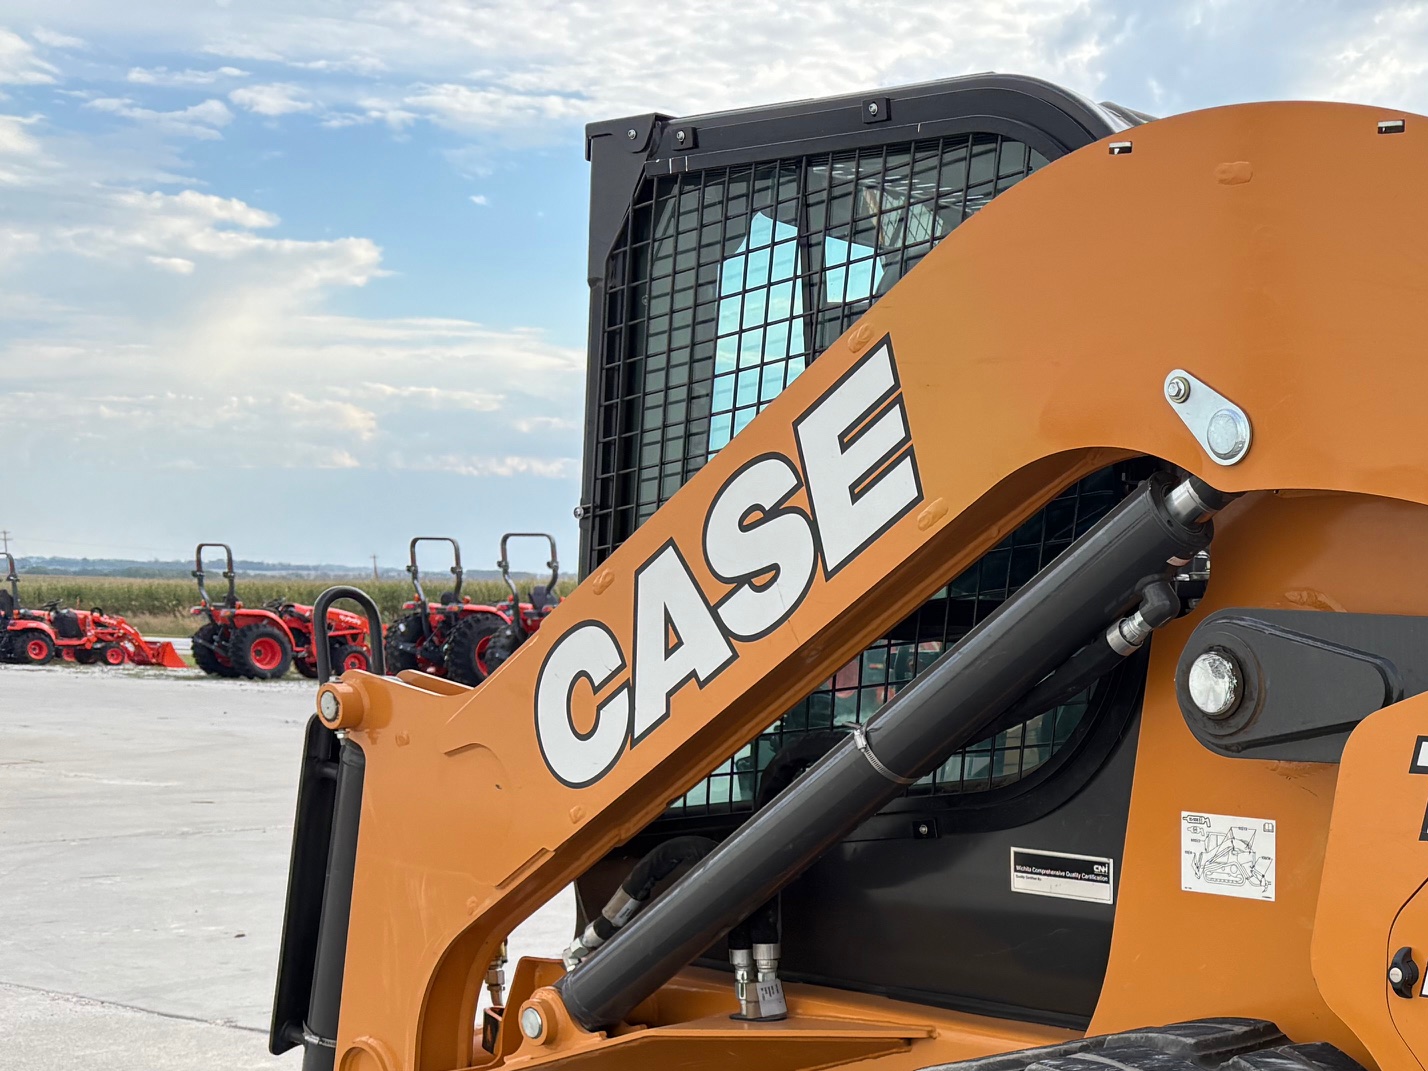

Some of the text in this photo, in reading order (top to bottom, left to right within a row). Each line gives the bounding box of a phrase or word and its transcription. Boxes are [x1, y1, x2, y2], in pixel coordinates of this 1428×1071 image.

[534, 331, 924, 789] CASE
[1032, 867, 1065, 876] Comprehensive
[1066, 871, 1081, 879] Quality
[1082, 873, 1108, 882] Certification
